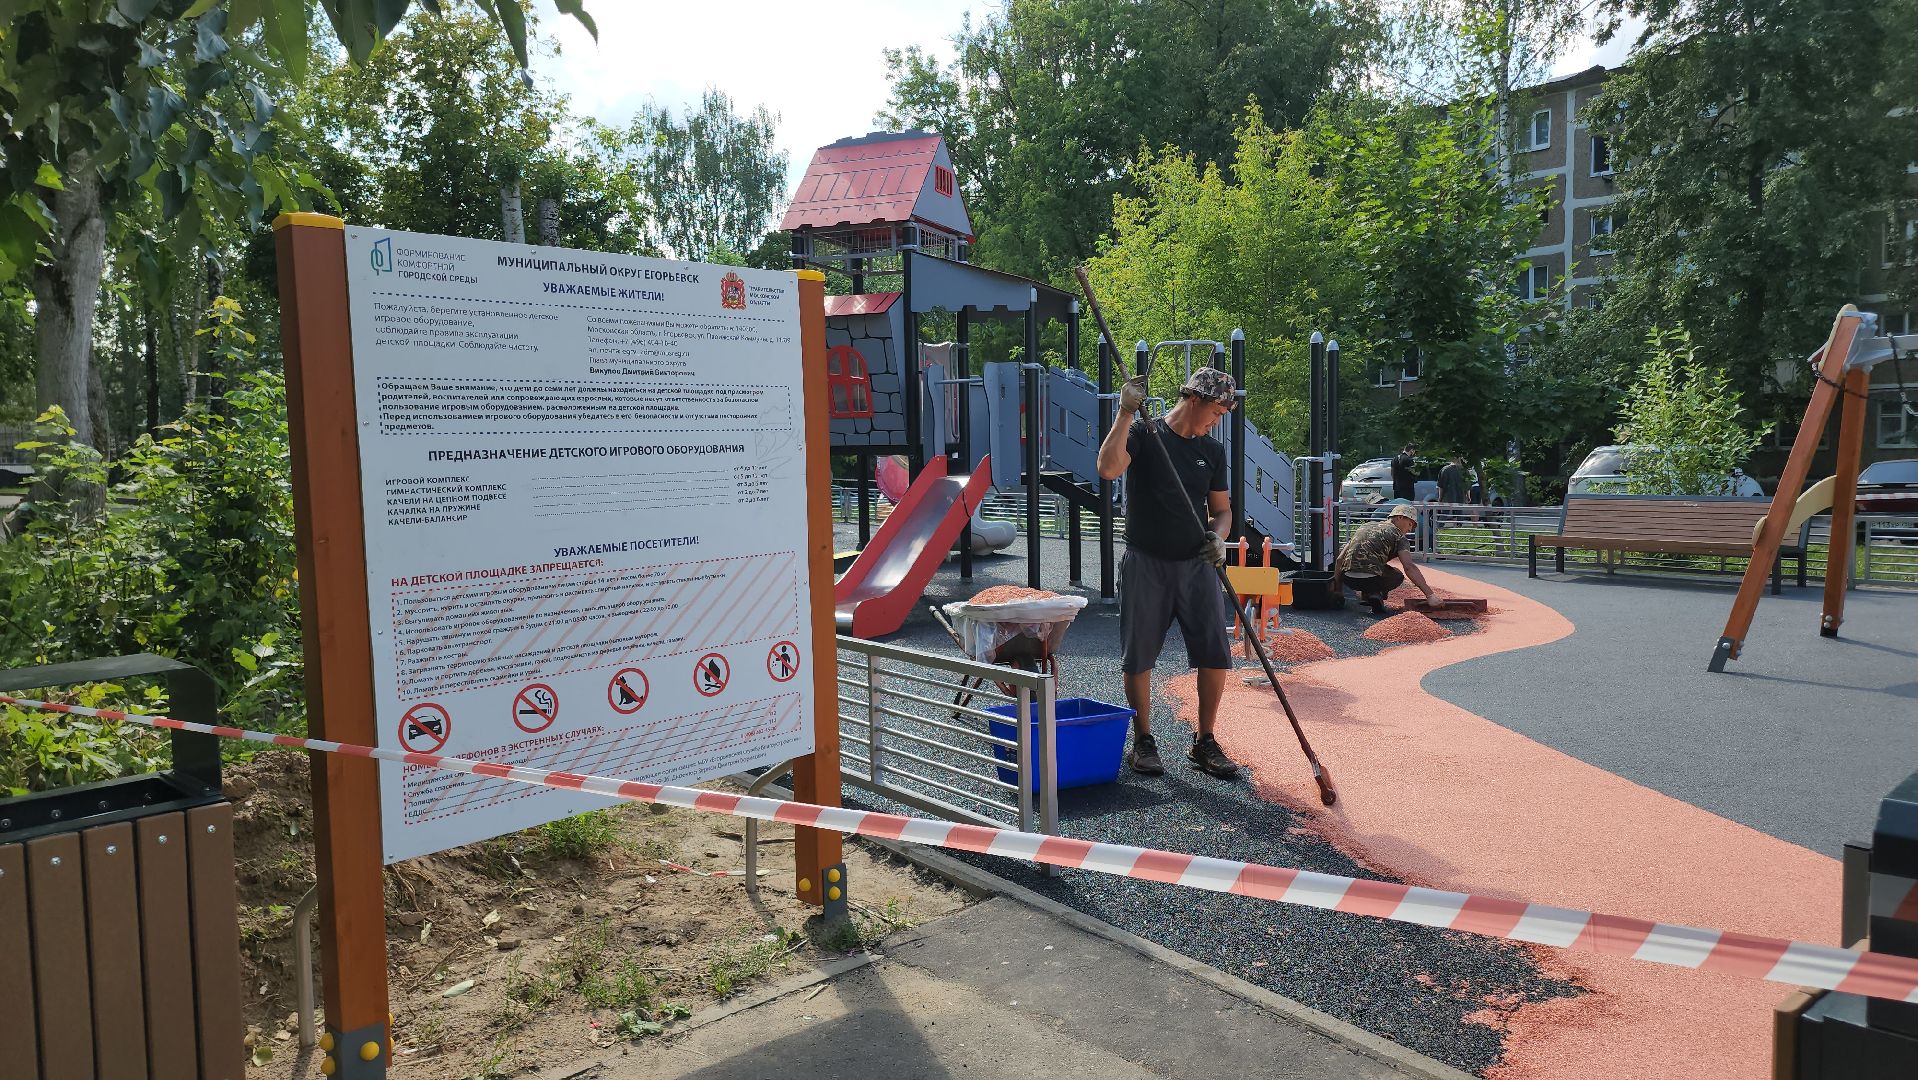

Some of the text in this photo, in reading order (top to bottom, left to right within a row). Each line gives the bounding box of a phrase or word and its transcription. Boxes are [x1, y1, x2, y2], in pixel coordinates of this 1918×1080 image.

[497, 255, 699, 283] МУНИЦИПАЛЬНЫЙ ОКРУГ ЕГОРЬЕВСК
[398, 270, 477, 284] ГОРОДСКОЙ СРЕДЫ
[542, 282, 664, 301] УВАЖАЕМЫЕ ЖИТЕЛИ!
[374, 315, 410, 323] игровое
[469, 310, 527, 318] установленное
[458, 340, 506, 350] Соблюдайте
[381, 382, 428, 391] Обращаем
[382, 413, 411, 421] Перед
[522, 412, 576, 420] оборудования
[384, 423, 435, 431] предметов.
[428, 444, 744, 462] ПРЕДНАЗНАЧЕНИЕ ДЕТСКОГО ИГРОВОГО ОБОРУДОВАНИЯ
[385, 475, 469, 485] ИГРОВОЙ КОМПЛЕКС
[386, 483, 506, 495] ГИМНАСТИЧЕСКИЙ КОМПЛЕКС
[386, 497, 420, 505] КАЧЕЛИ
[435, 494, 469, 504] ЦЕПНОМ
[471, 493, 506, 501] ПОДВЕСЕ
[387, 507, 427, 515] КАЧАЛКА
[442, 503, 480, 512] ПРУЖИНЕ
[388, 514, 467, 525] КАЧЕЛИ-БАЛАНСИР
[553, 535, 699, 557] УВАЖАЕМЫЕ ПОСЕТИТЕЛИ!
[391, 558, 604, 586] НА ДЕТСКОЙ ПЛОЩАДКЕ ЗАПРЕЩАЕТСЯ:
[507, 732, 563, 751] ЭКСТРЕННЫХ
[564, 725, 604, 739] СЛУЧАЯХ:
